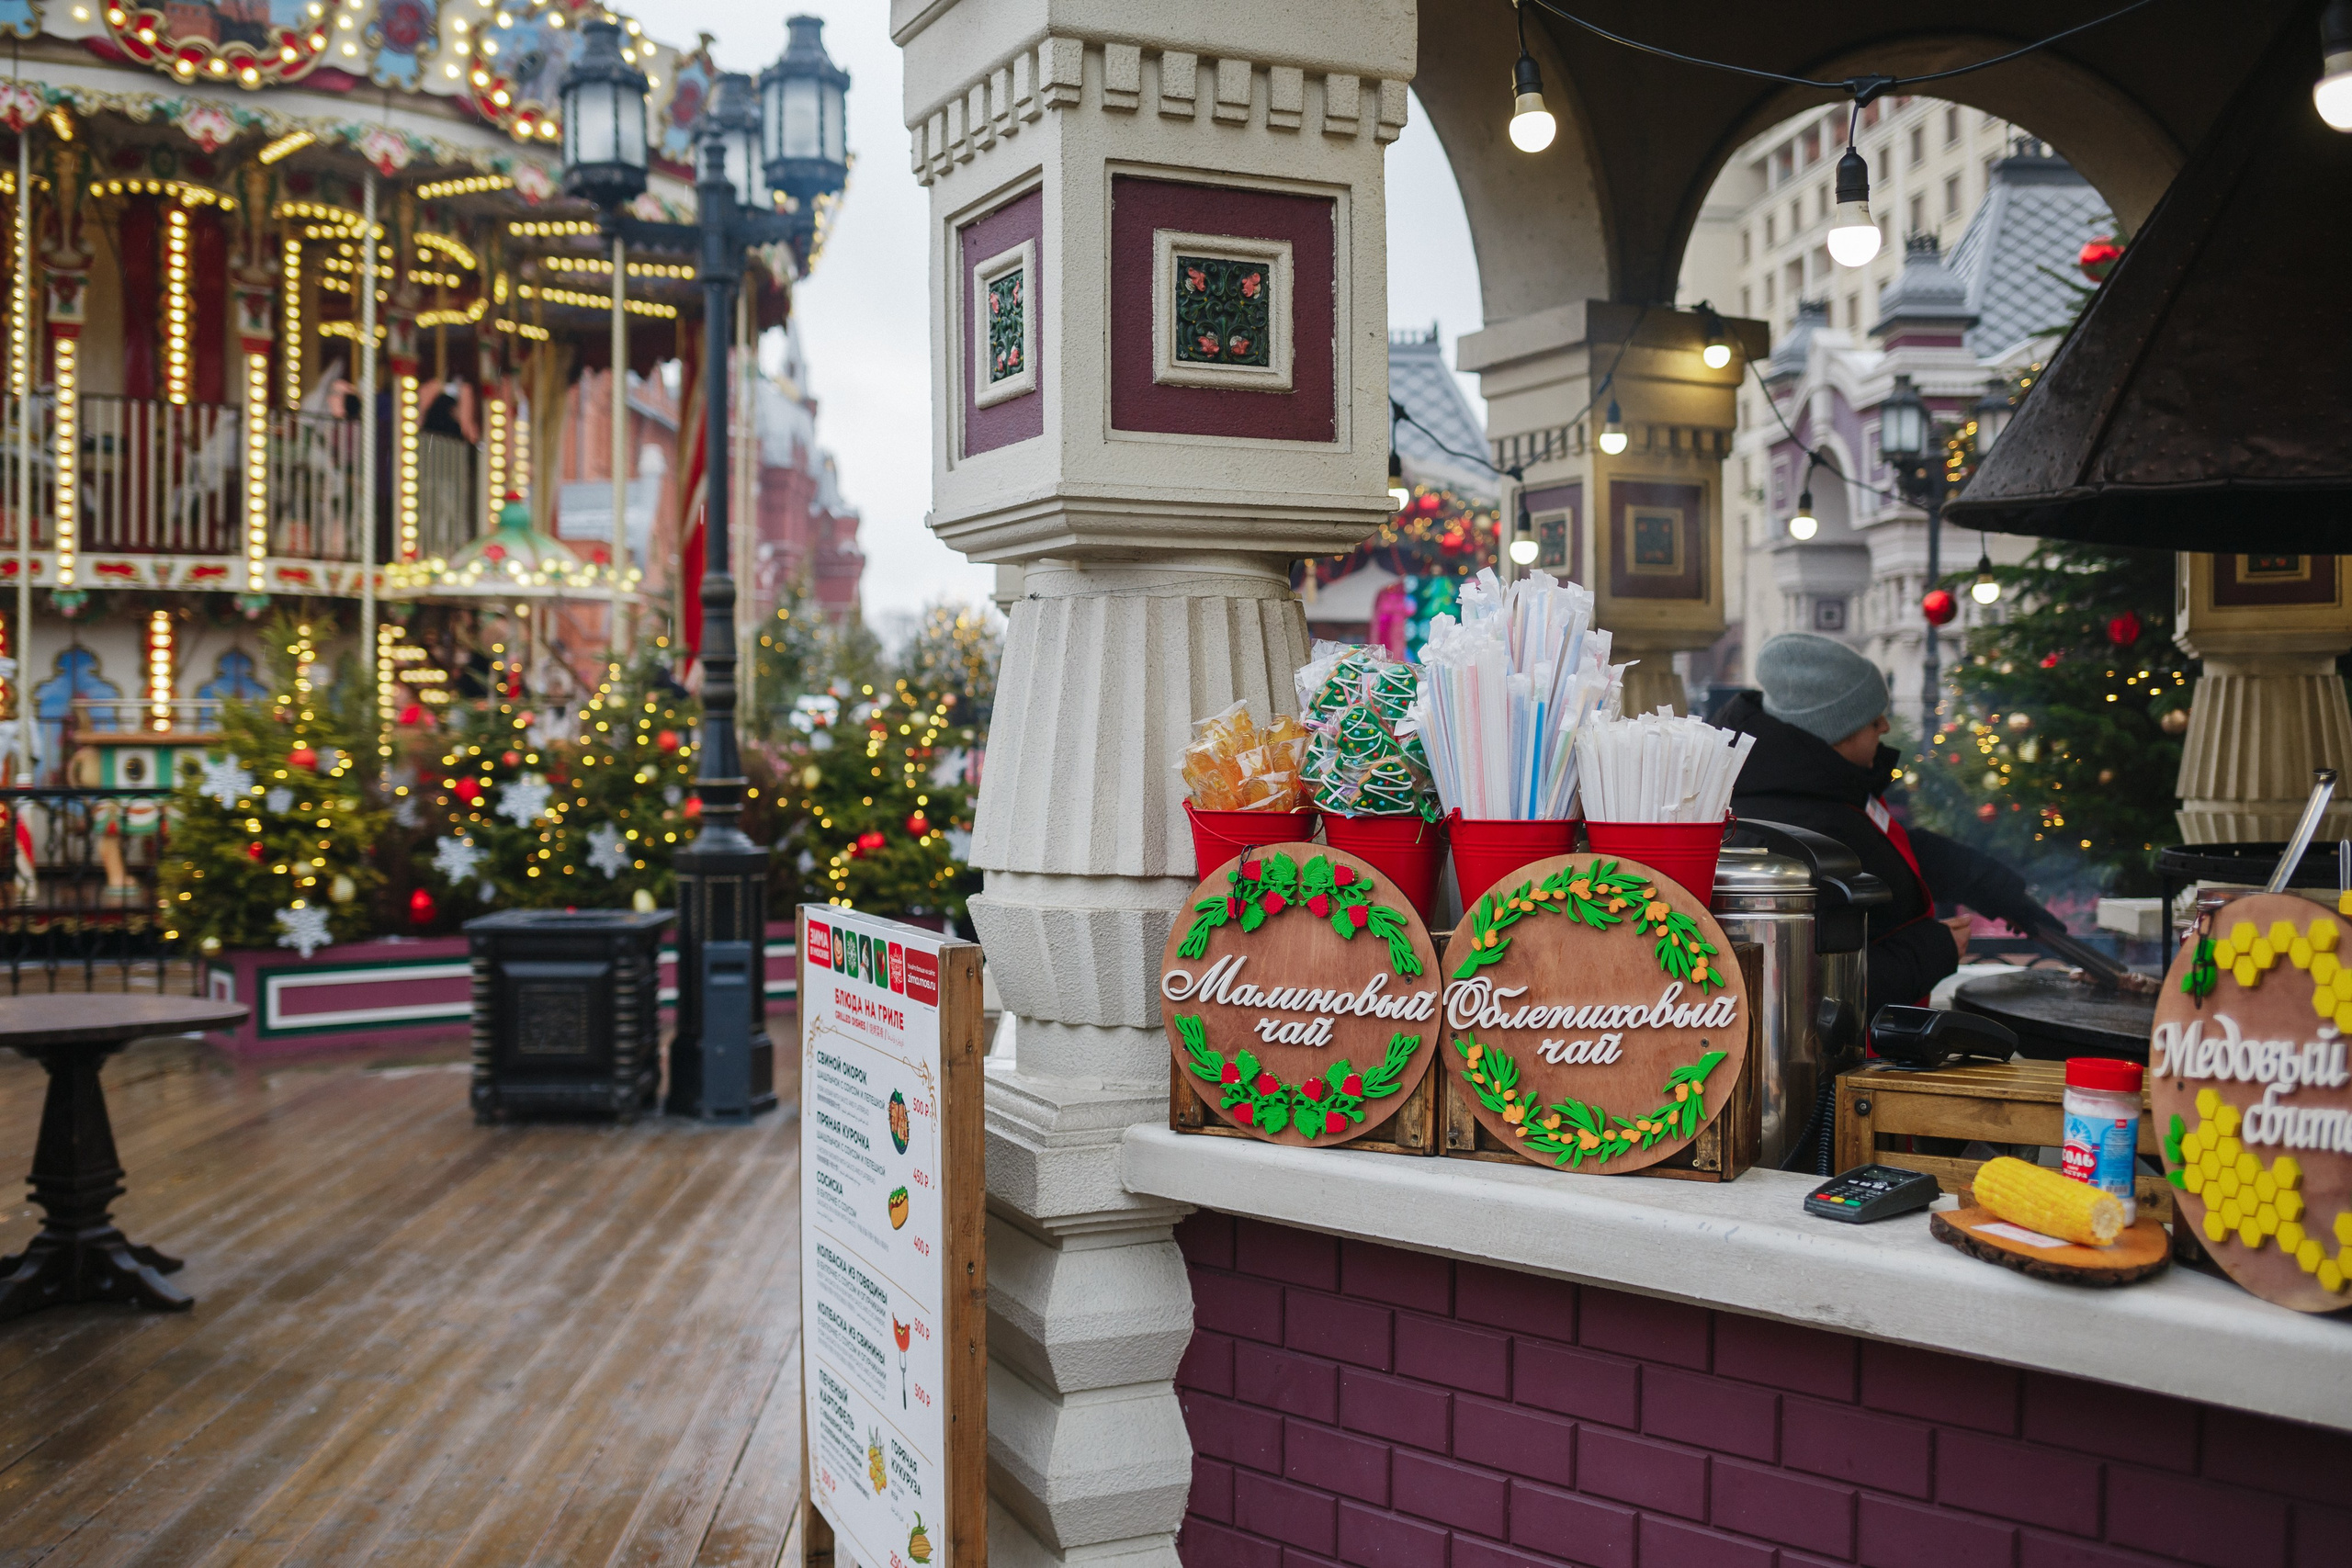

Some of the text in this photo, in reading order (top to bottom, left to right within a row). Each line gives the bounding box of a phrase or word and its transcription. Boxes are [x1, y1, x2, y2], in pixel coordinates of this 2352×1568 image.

[810, 928, 829, 949] ЗИМА
[908, 973, 936, 990] zima.mos.ru
[1161, 954, 1438, 1021] Малиновый
[835, 987, 904, 1031] БЛЮДА НА ГРИЛЕ
[835, 1010, 865, 1031] GRILLED DISHES
[1442, 976, 1738, 1030] Облепиховый
[1254, 1017, 1335, 1047] чай
[1537, 1032, 1623, 1065] чай
[2153, 1014, 2350, 1087] Медовый
[817, 1051, 867, 1086] СВИНОЙ ОКОРОК
[913, 1097, 923, 1115] 500
[817, 1111, 841, 1134] ПРЯНАЯ
[842, 1122, 870, 1151] КУРОЧКА
[817, 1170, 843, 1196] СОСИСКА
[913, 1168, 923, 1185] 450
[913, 1235, 924, 1254] 400
[817, 1242, 847, 1273] КОЛБАСКА
[848, 1264, 855, 1280] ИЗ
[856, 1270, 888, 1305] ГОВЯДИНЫ
[817, 1300, 847, 1333] КОЛБАСКА
[849, 1323, 855, 1340] ИЗ
[857, 1331, 885, 1366] СВИНИНЫ
[914, 1317, 924, 1337] 500
[820, 1369, 848, 1405] ПЕЧЕНЫЙ
[915, 1382, 924, 1404] 500
[820, 1387, 854, 1431] КАРТОФЕЛЬ
[891, 1438, 917, 1475] ГОРЯЧАЯ
[891, 1457, 922, 1499] КУКУРУЗА
